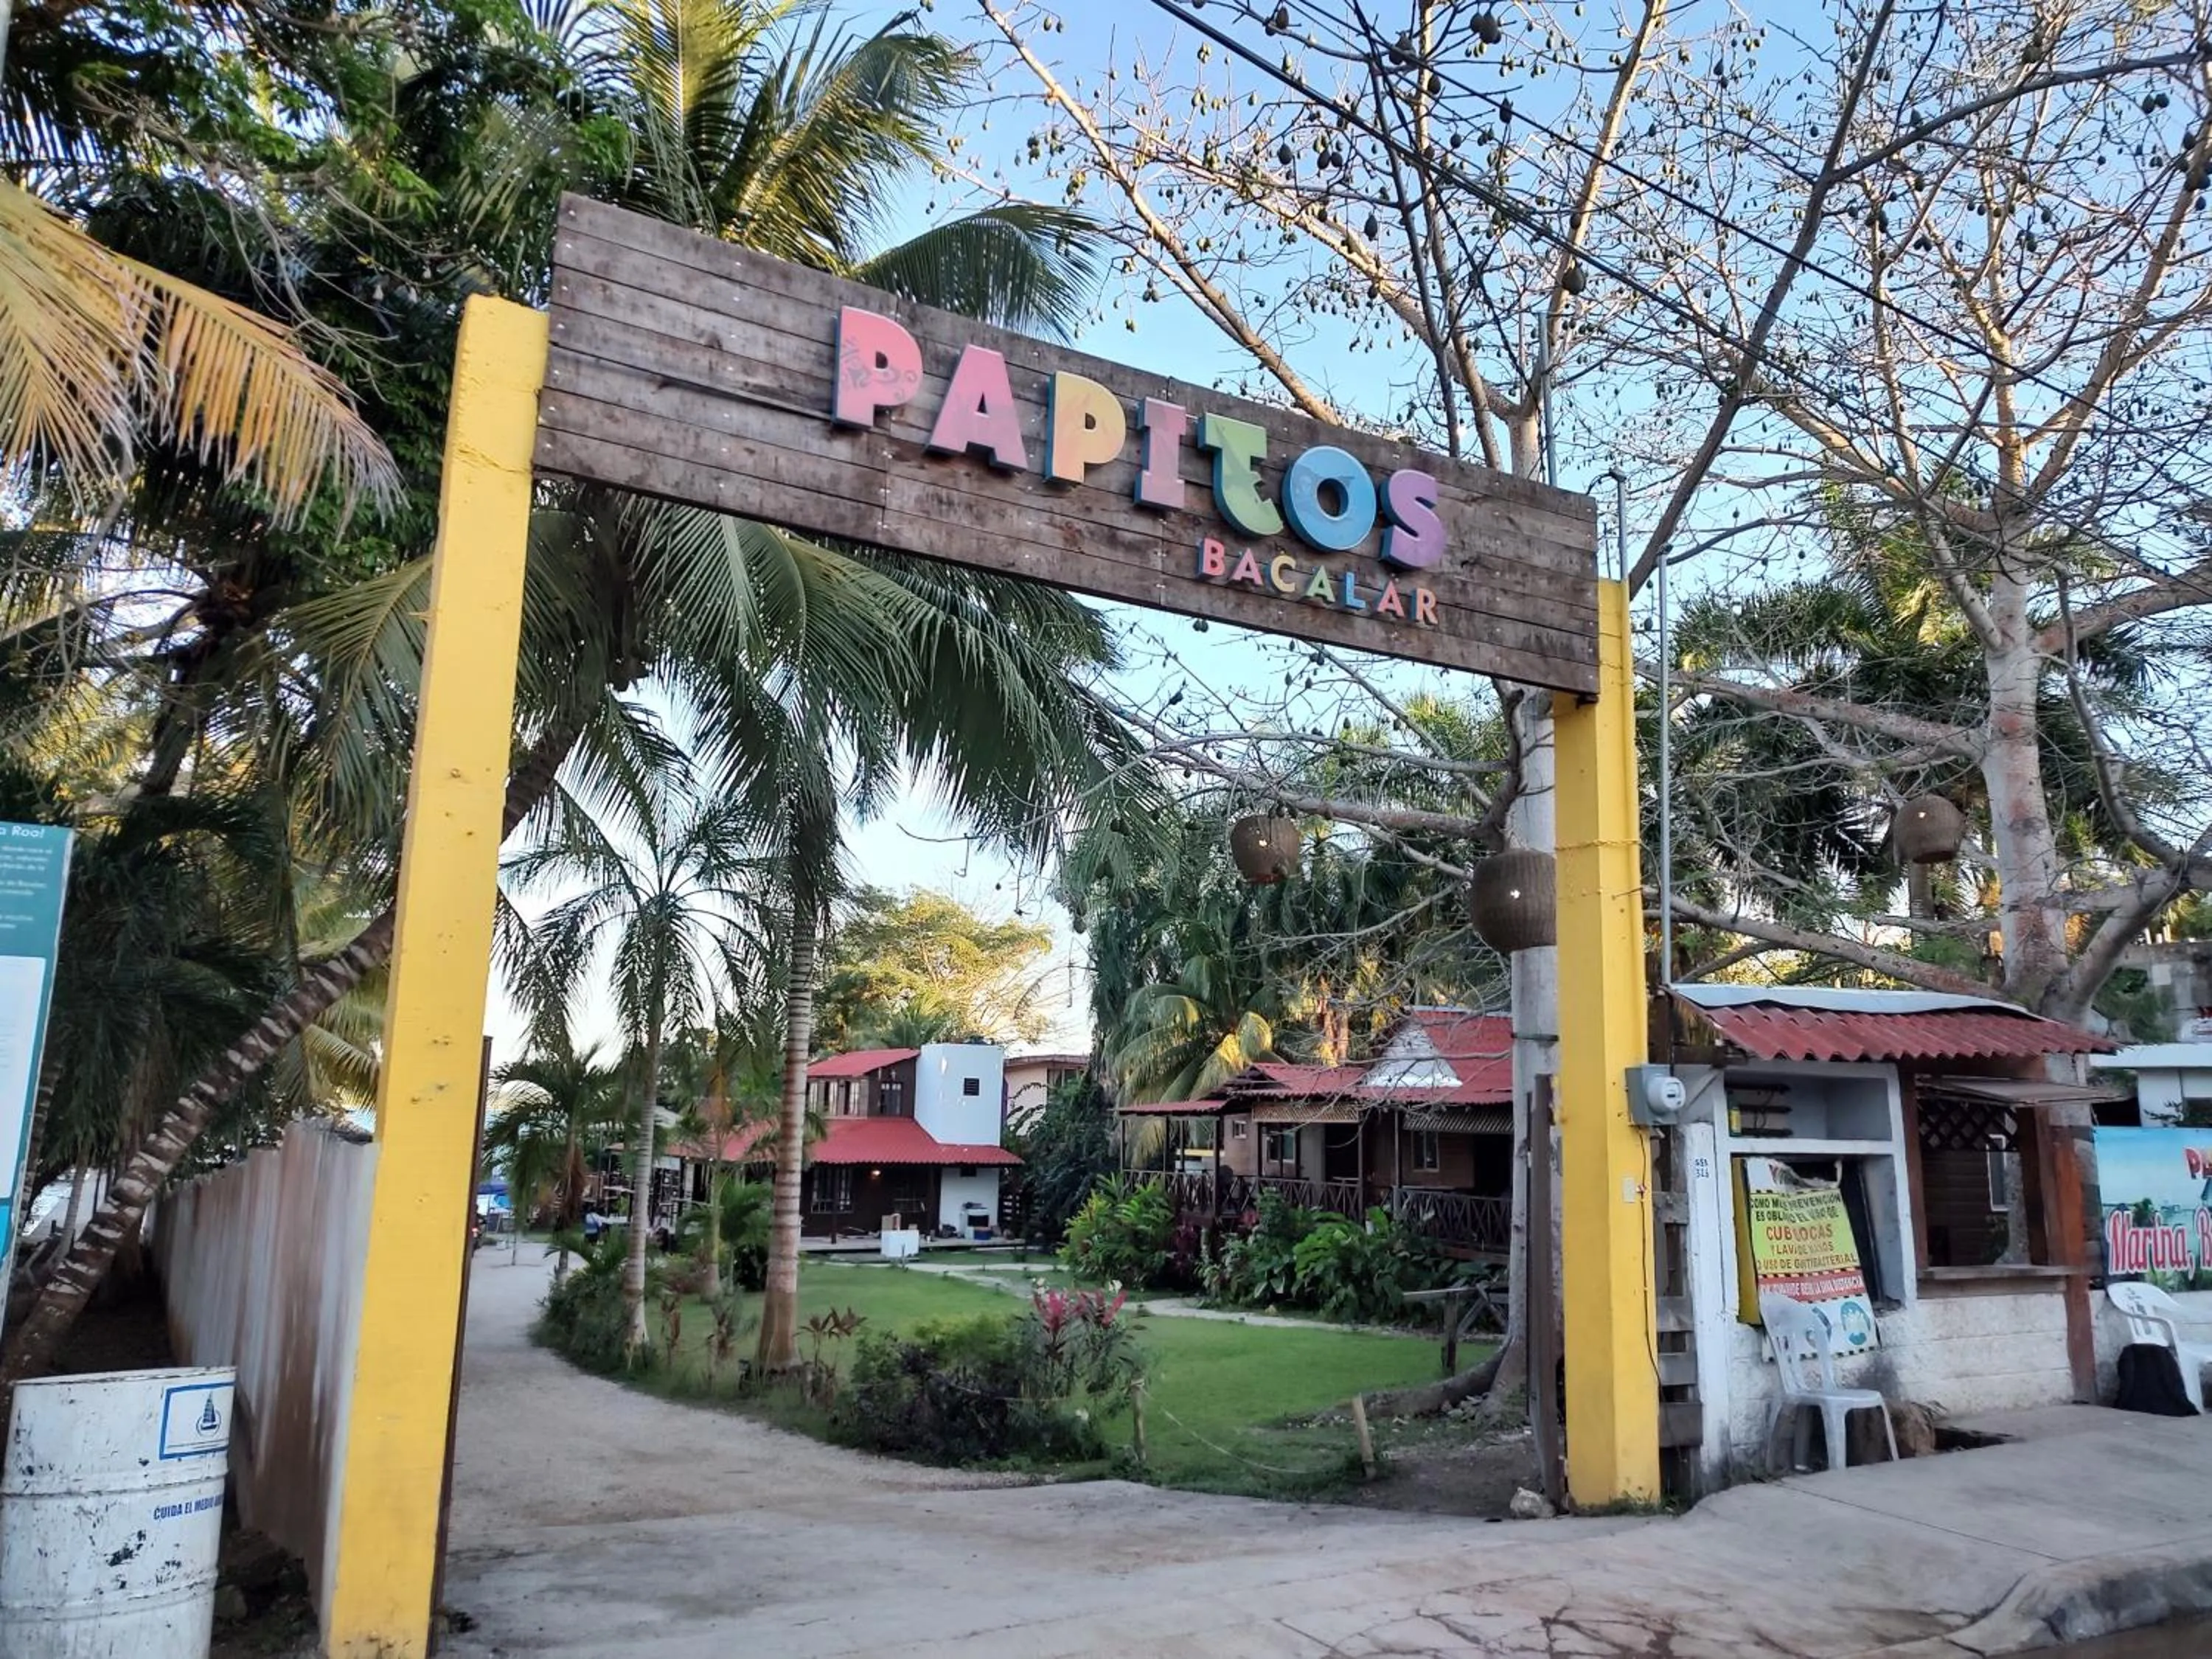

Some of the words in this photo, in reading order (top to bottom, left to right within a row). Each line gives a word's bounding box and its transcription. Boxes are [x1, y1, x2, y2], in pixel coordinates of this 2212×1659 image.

[831, 305, 1447, 571] PAPITOS
[1198, 537, 1439, 625] BACALAR
[153, 1503, 182, 1520] CUIDA
